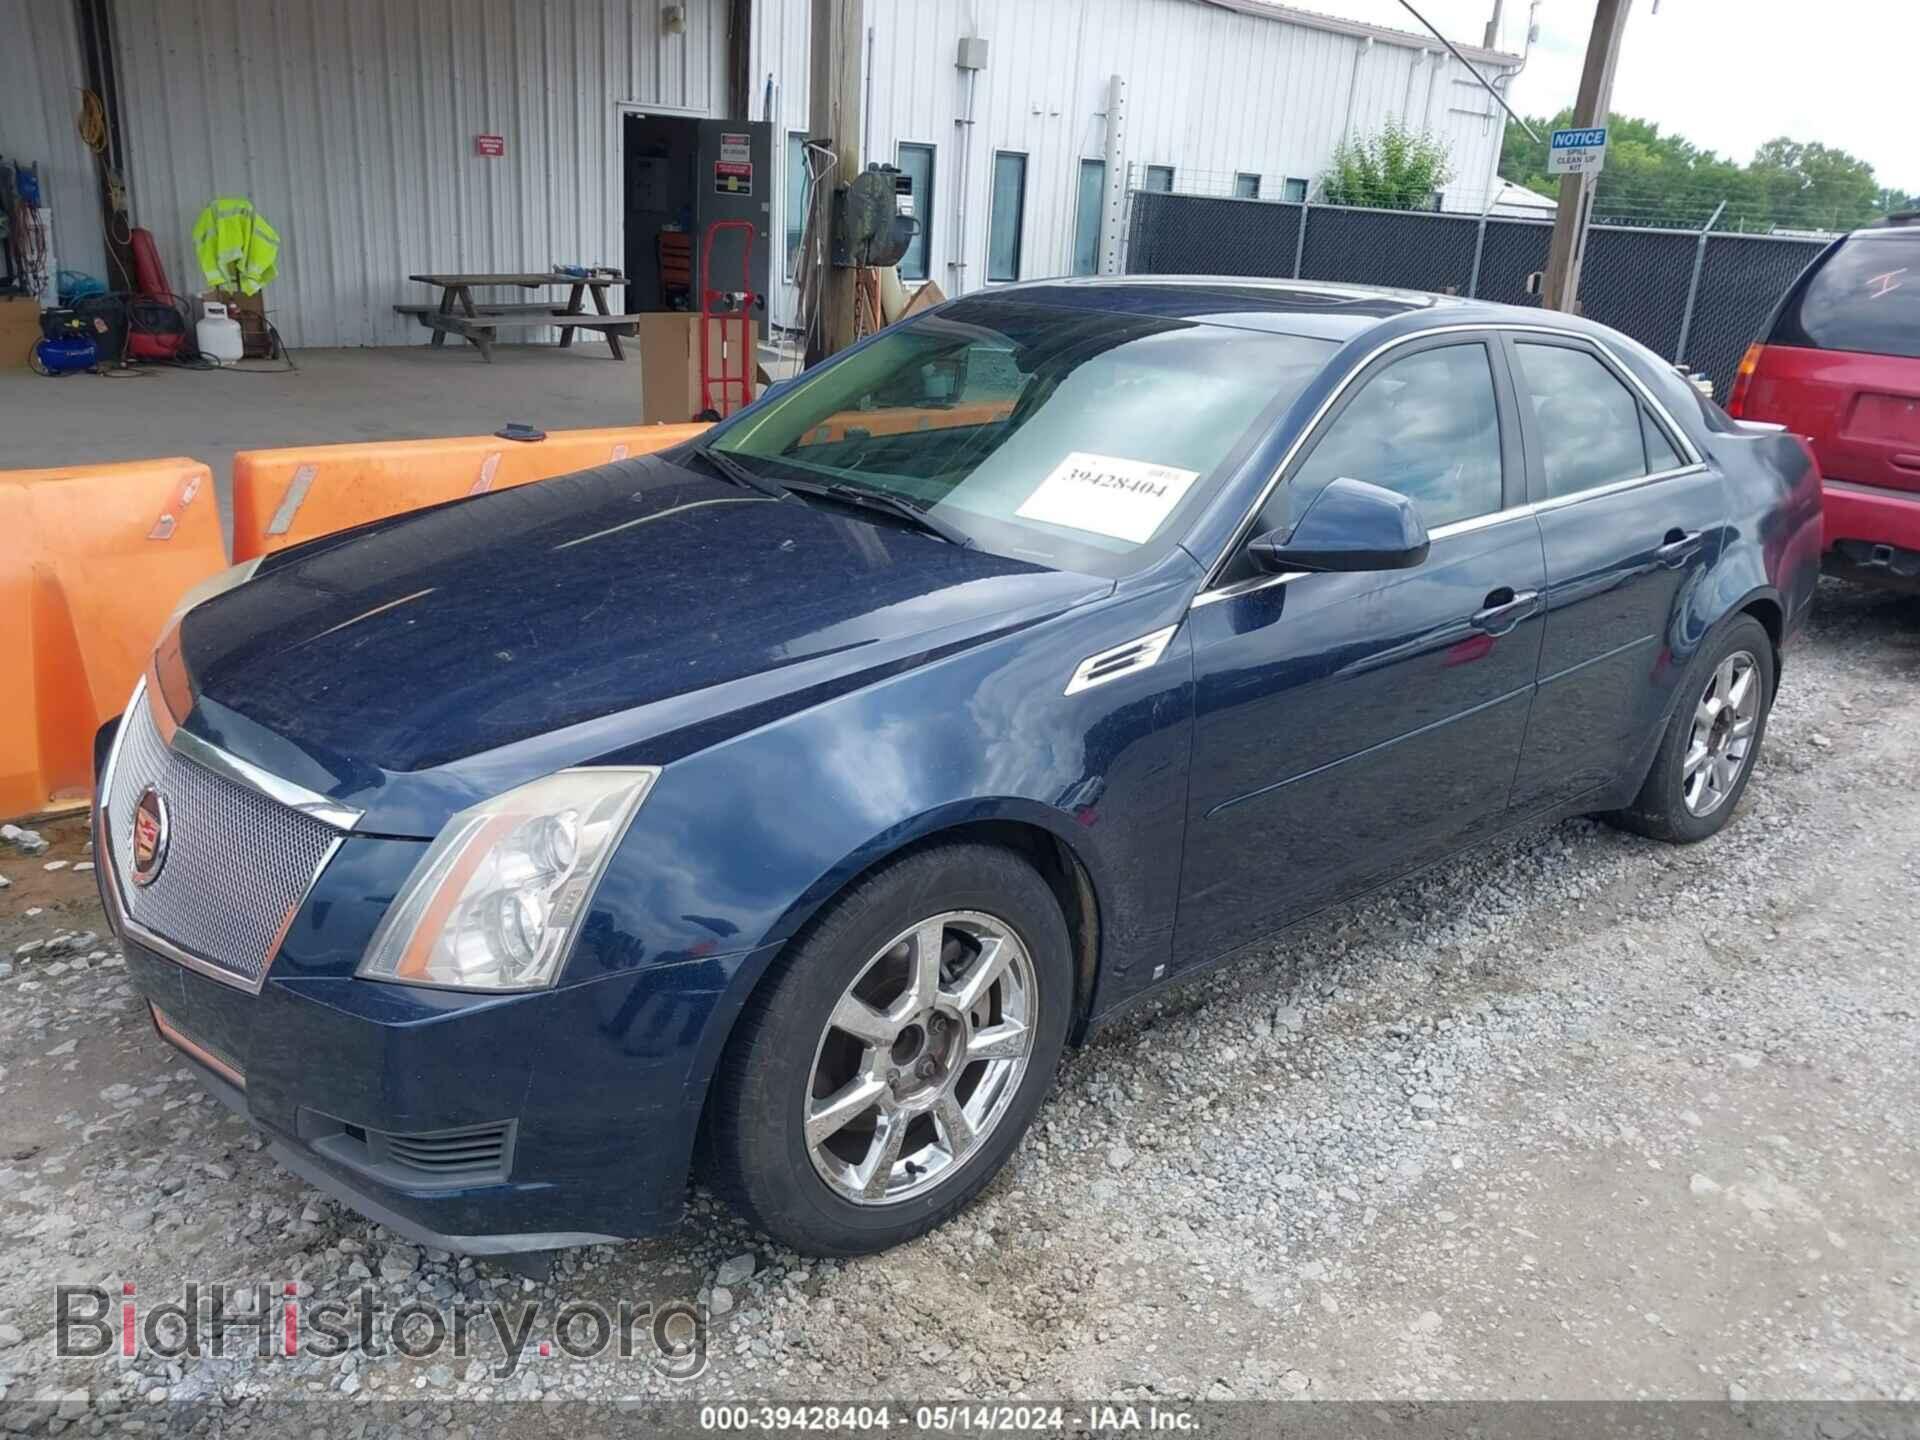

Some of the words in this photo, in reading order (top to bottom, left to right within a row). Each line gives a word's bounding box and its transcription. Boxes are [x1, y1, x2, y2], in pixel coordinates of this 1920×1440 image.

[1554, 131, 1604, 146] NOTICE
[1557, 156, 1582, 165] CLEAN
[1584, 155, 1597, 163] UP
[1062, 468, 1167, 497] 39428404
